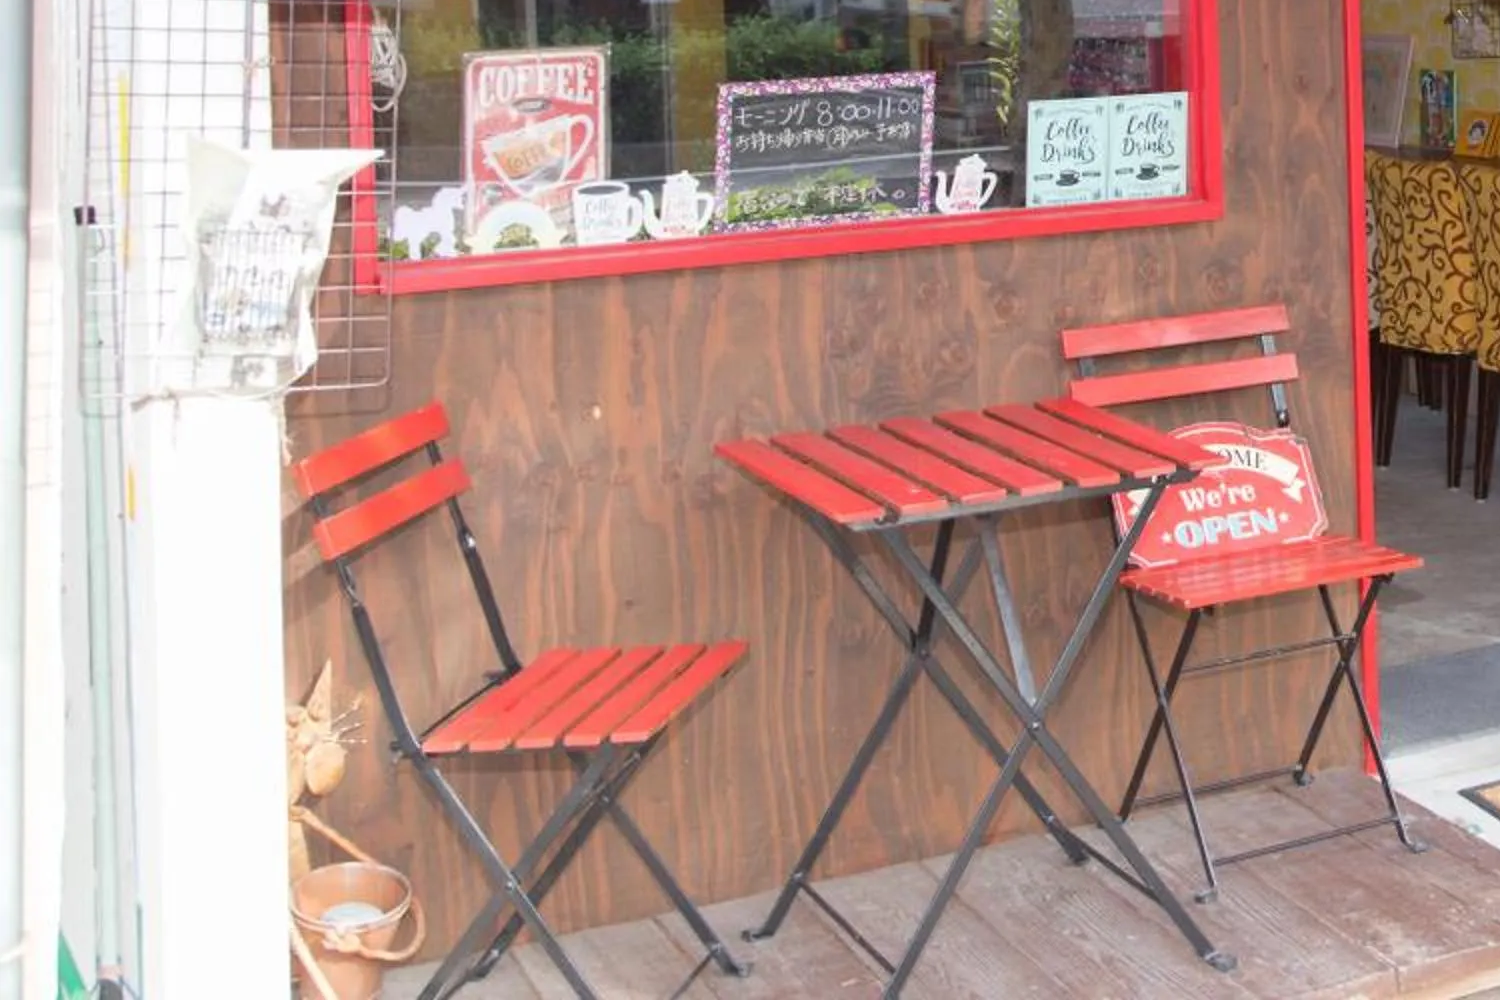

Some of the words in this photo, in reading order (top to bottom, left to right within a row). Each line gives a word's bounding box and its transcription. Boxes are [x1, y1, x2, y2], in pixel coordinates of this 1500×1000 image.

[478, 62, 594, 107] COFFEE
[1178, 481, 1256, 512] We're
[1174, 507, 1279, 548] OPEN
